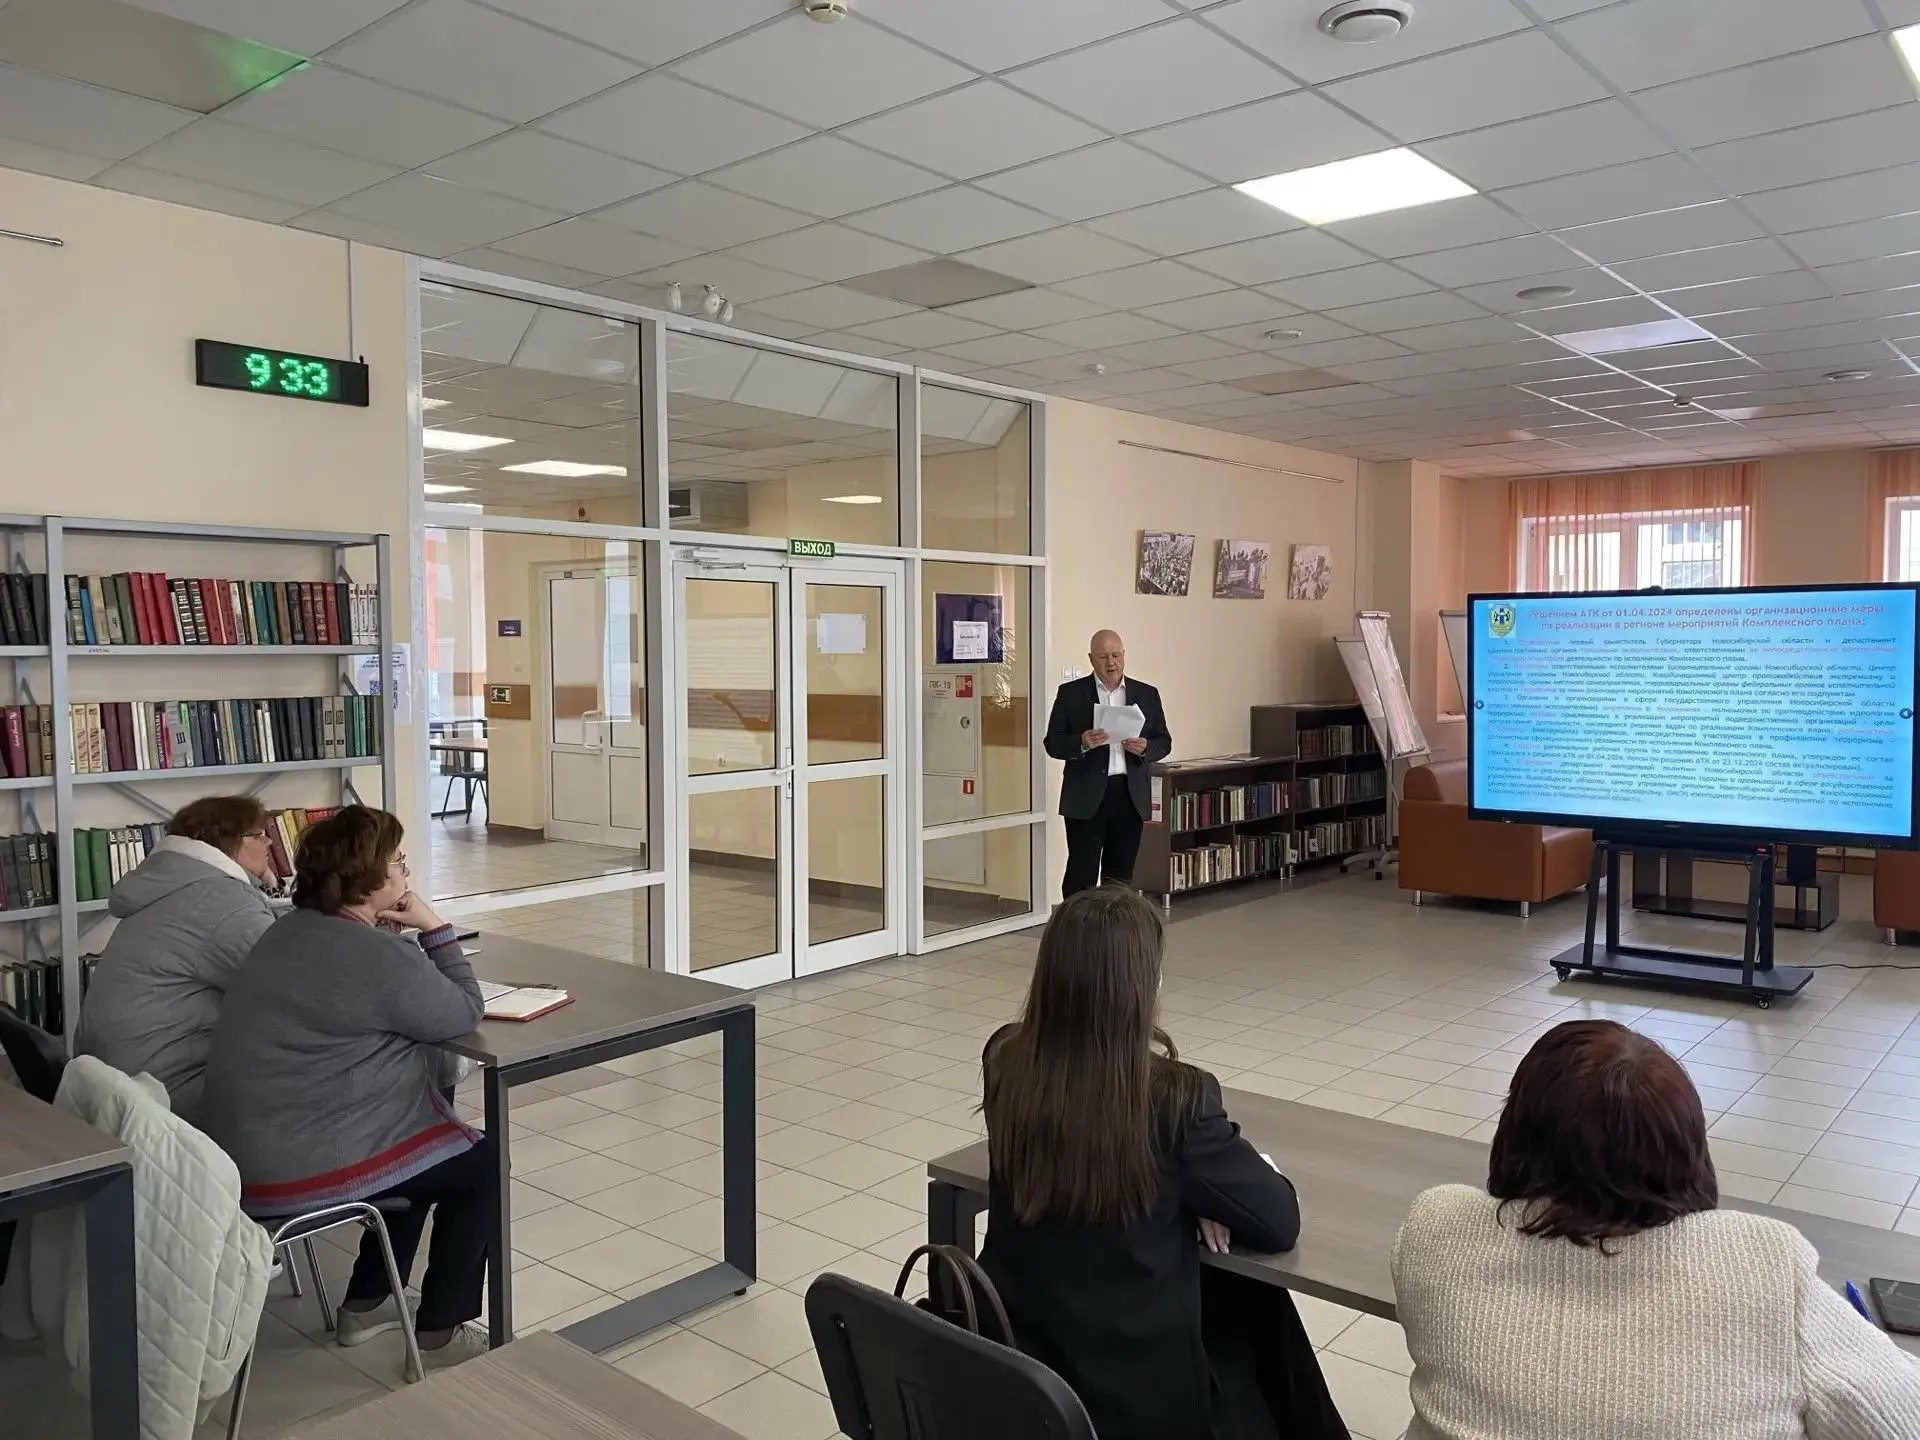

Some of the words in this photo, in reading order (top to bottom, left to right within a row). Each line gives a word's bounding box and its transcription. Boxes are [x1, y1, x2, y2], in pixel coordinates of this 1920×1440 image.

[244, 352, 271, 389] 9
[279, 358, 328, 396] 33
[794, 541, 832, 556] ВЫХОД
[1615, 608, 1673, 616] 01.04.2024
[1675, 608, 1742, 617] определены
[1745, 606, 1847, 615] организационные
[1851, 605, 1884, 614] меры
[1556, 622, 1611, 630] реализации
[1624, 621, 1666, 629] регионе
[1668, 619, 1738, 629] мероприятий
[1743, 619, 1823, 627] Комплексного
